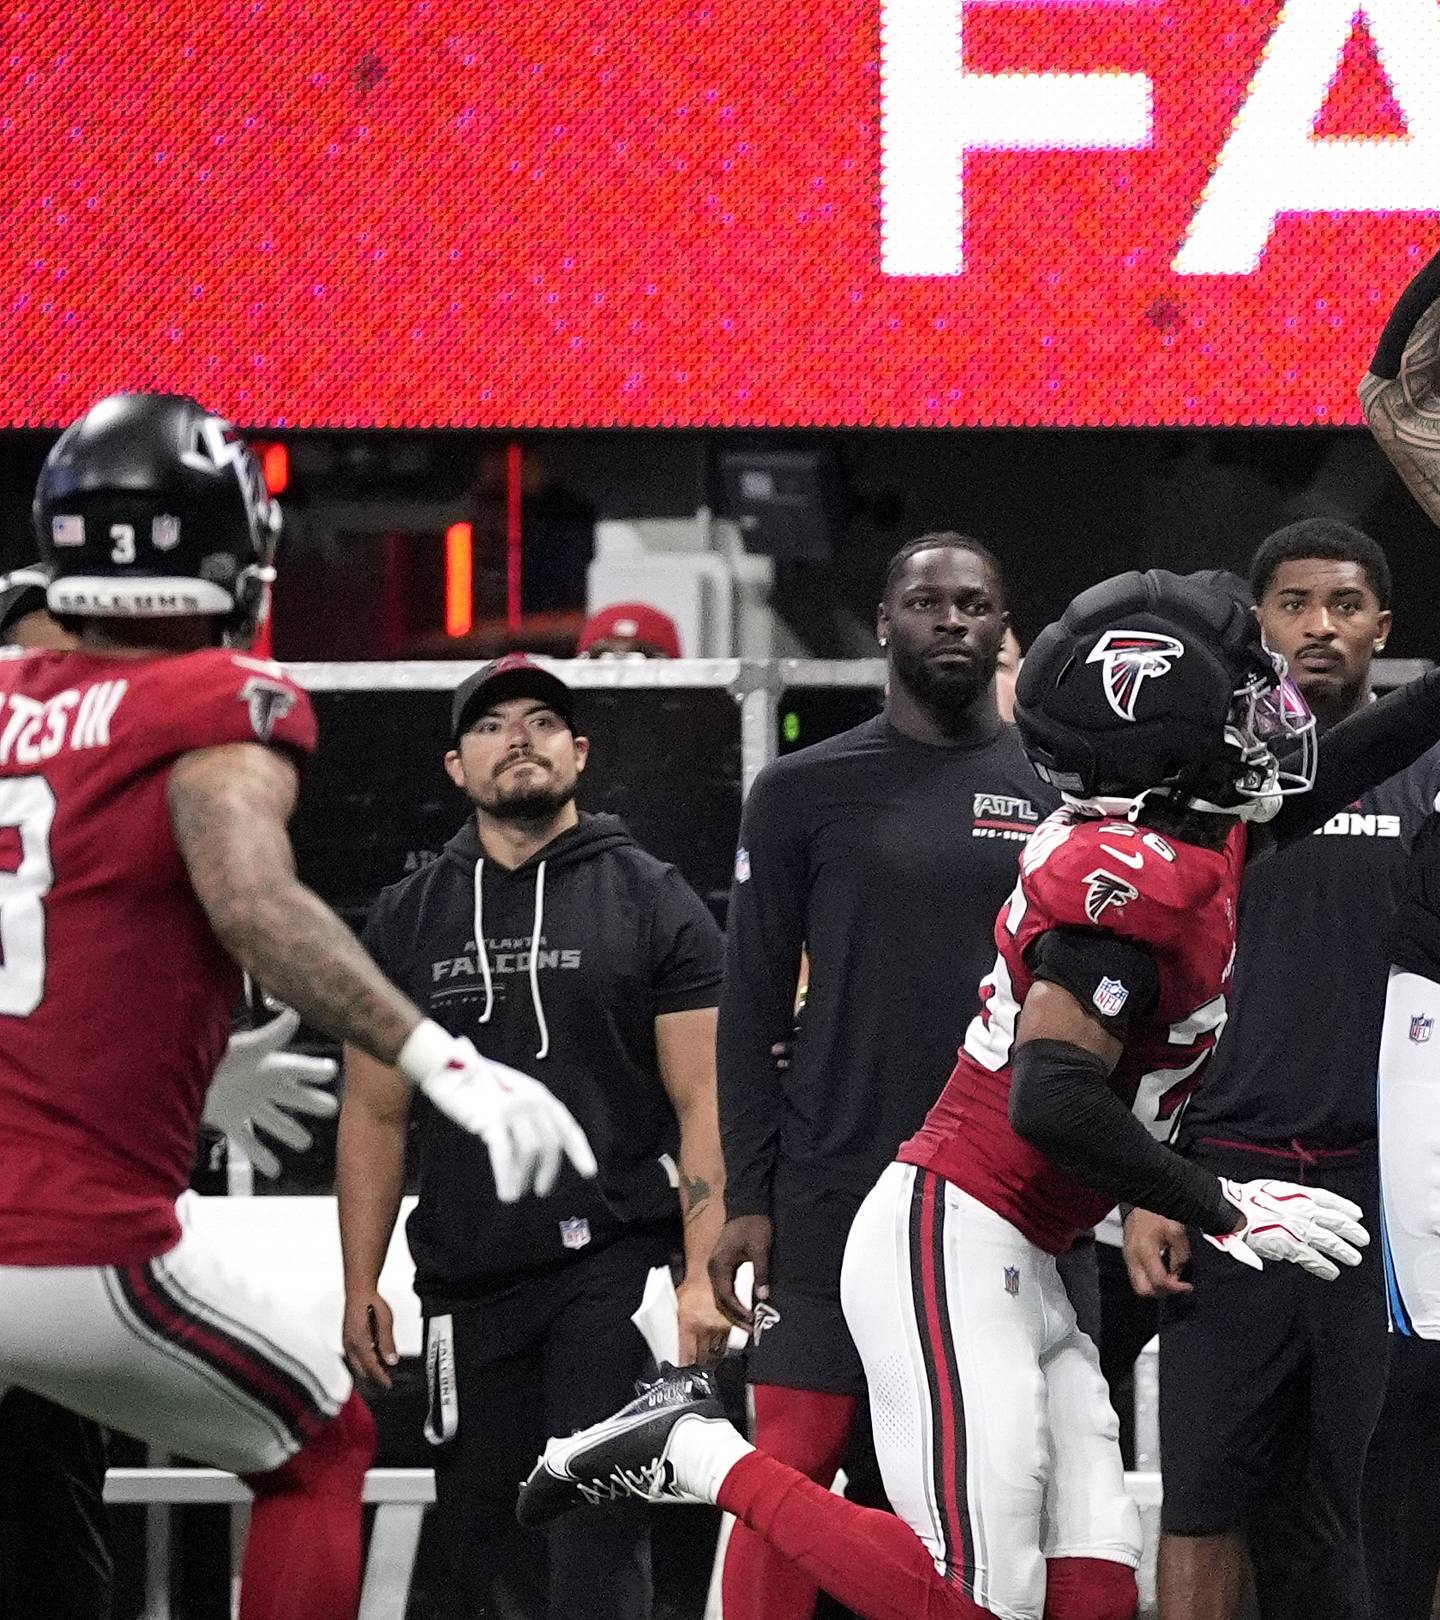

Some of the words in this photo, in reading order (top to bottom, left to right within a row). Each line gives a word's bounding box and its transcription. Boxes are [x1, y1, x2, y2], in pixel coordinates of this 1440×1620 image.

[110, 524, 136, 563] 3
[0, 691, 81, 766] TES
[973, 793, 1039, 820] ATL
[1312, 812, 1401, 837] ONS
[431, 949, 583, 983] FALCONS
